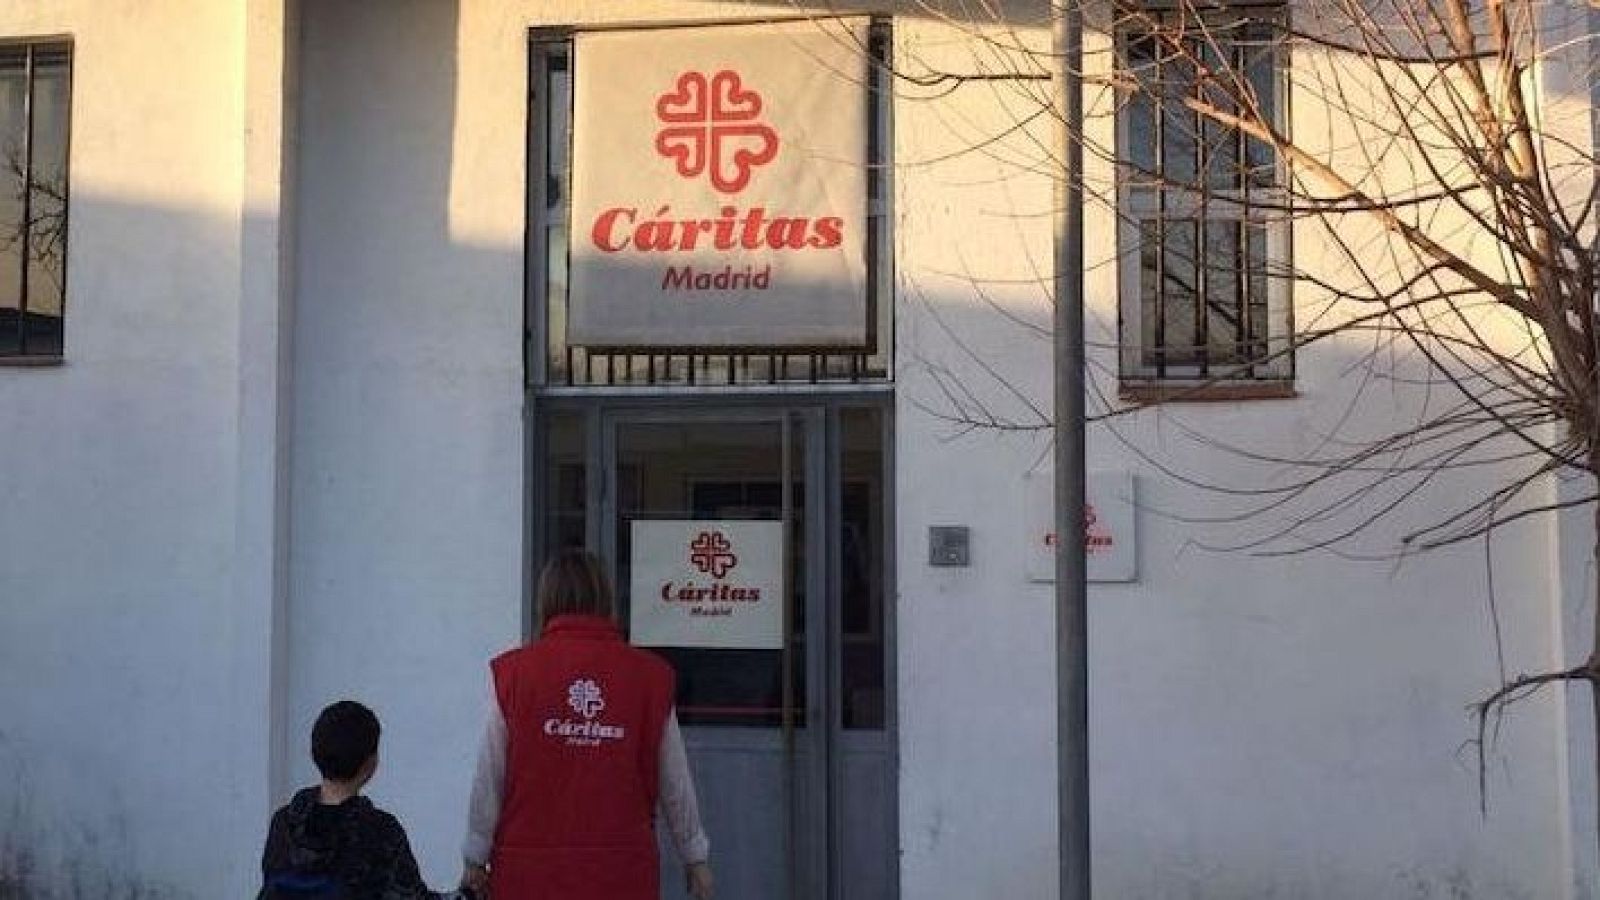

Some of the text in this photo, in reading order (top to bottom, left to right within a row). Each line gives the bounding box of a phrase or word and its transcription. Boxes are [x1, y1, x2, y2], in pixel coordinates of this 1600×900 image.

[591, 205, 844, 253] Cáritas
[661, 265, 771, 290] Madrid
[661, 582, 760, 601] Cáritas
